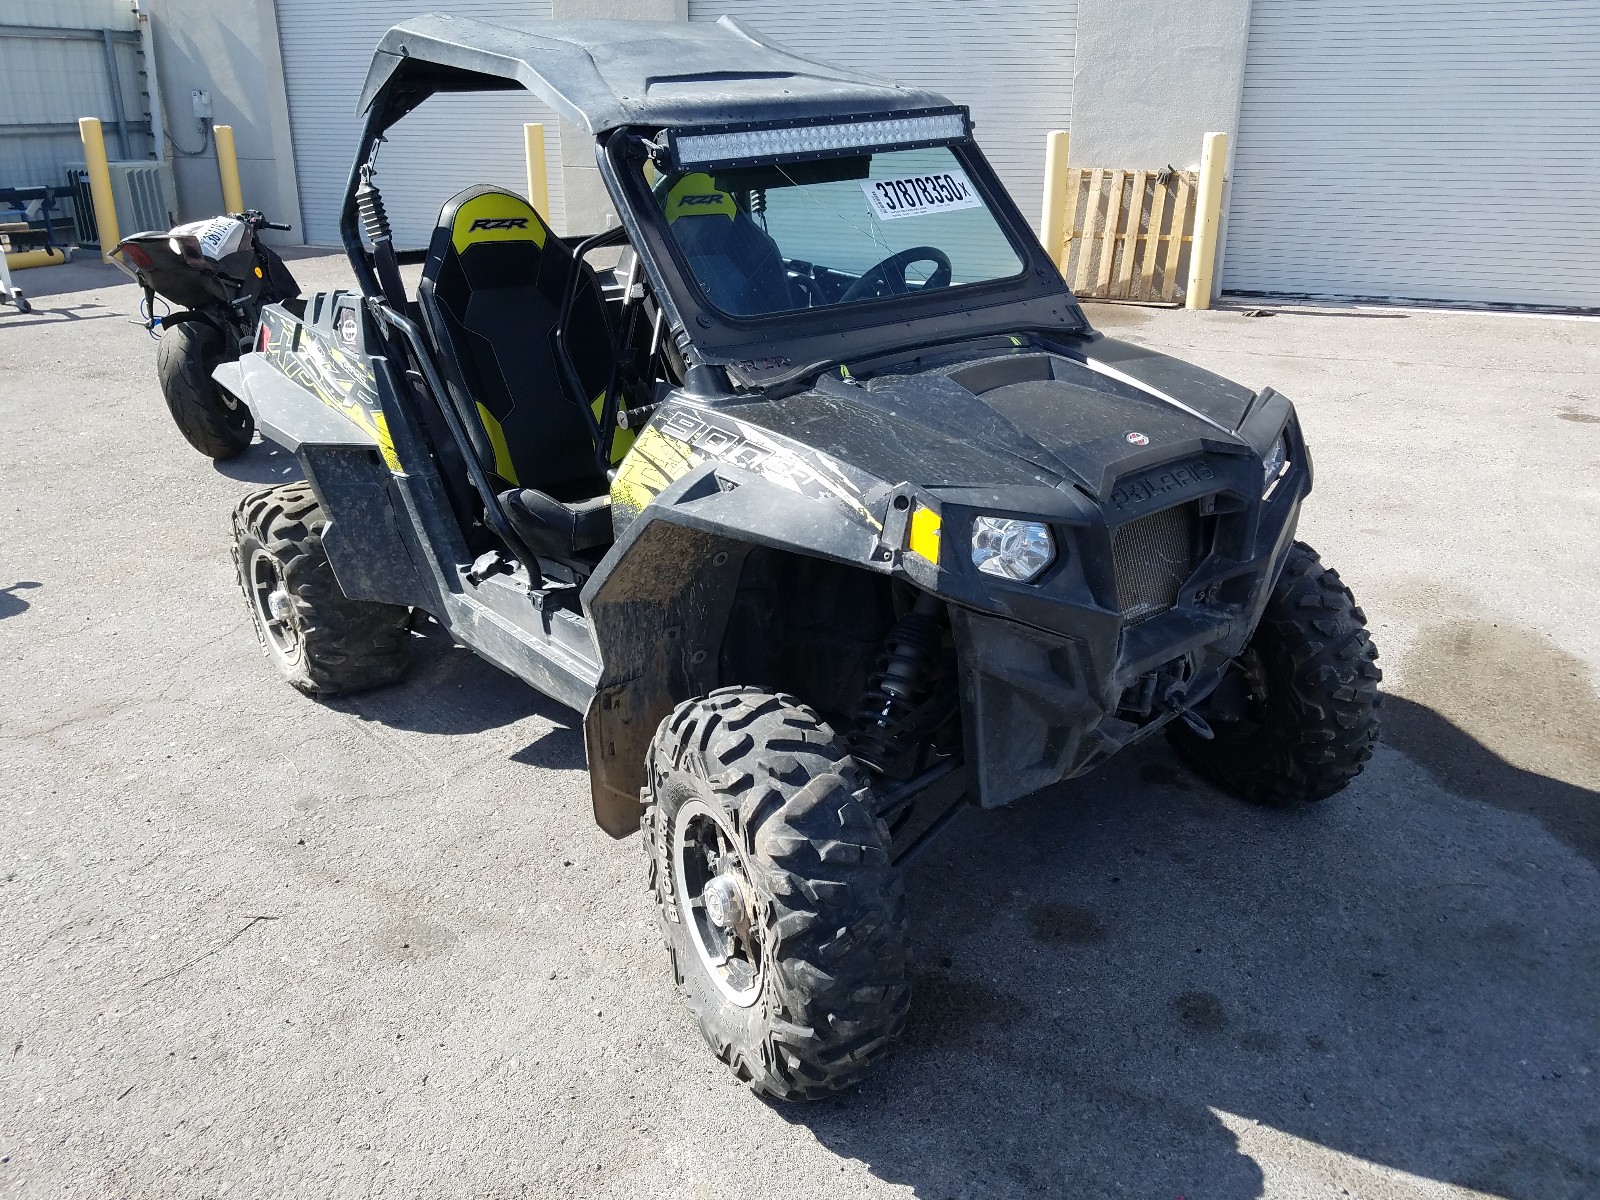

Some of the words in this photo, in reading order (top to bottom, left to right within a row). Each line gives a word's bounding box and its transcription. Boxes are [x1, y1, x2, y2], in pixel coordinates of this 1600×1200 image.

[679, 194, 725, 207] RZR
[875, 174, 963, 210] 37878350
[468, 218, 529, 233] RZR
[660, 410, 776, 470] 900
[1110, 461, 1215, 511] POLARIS
